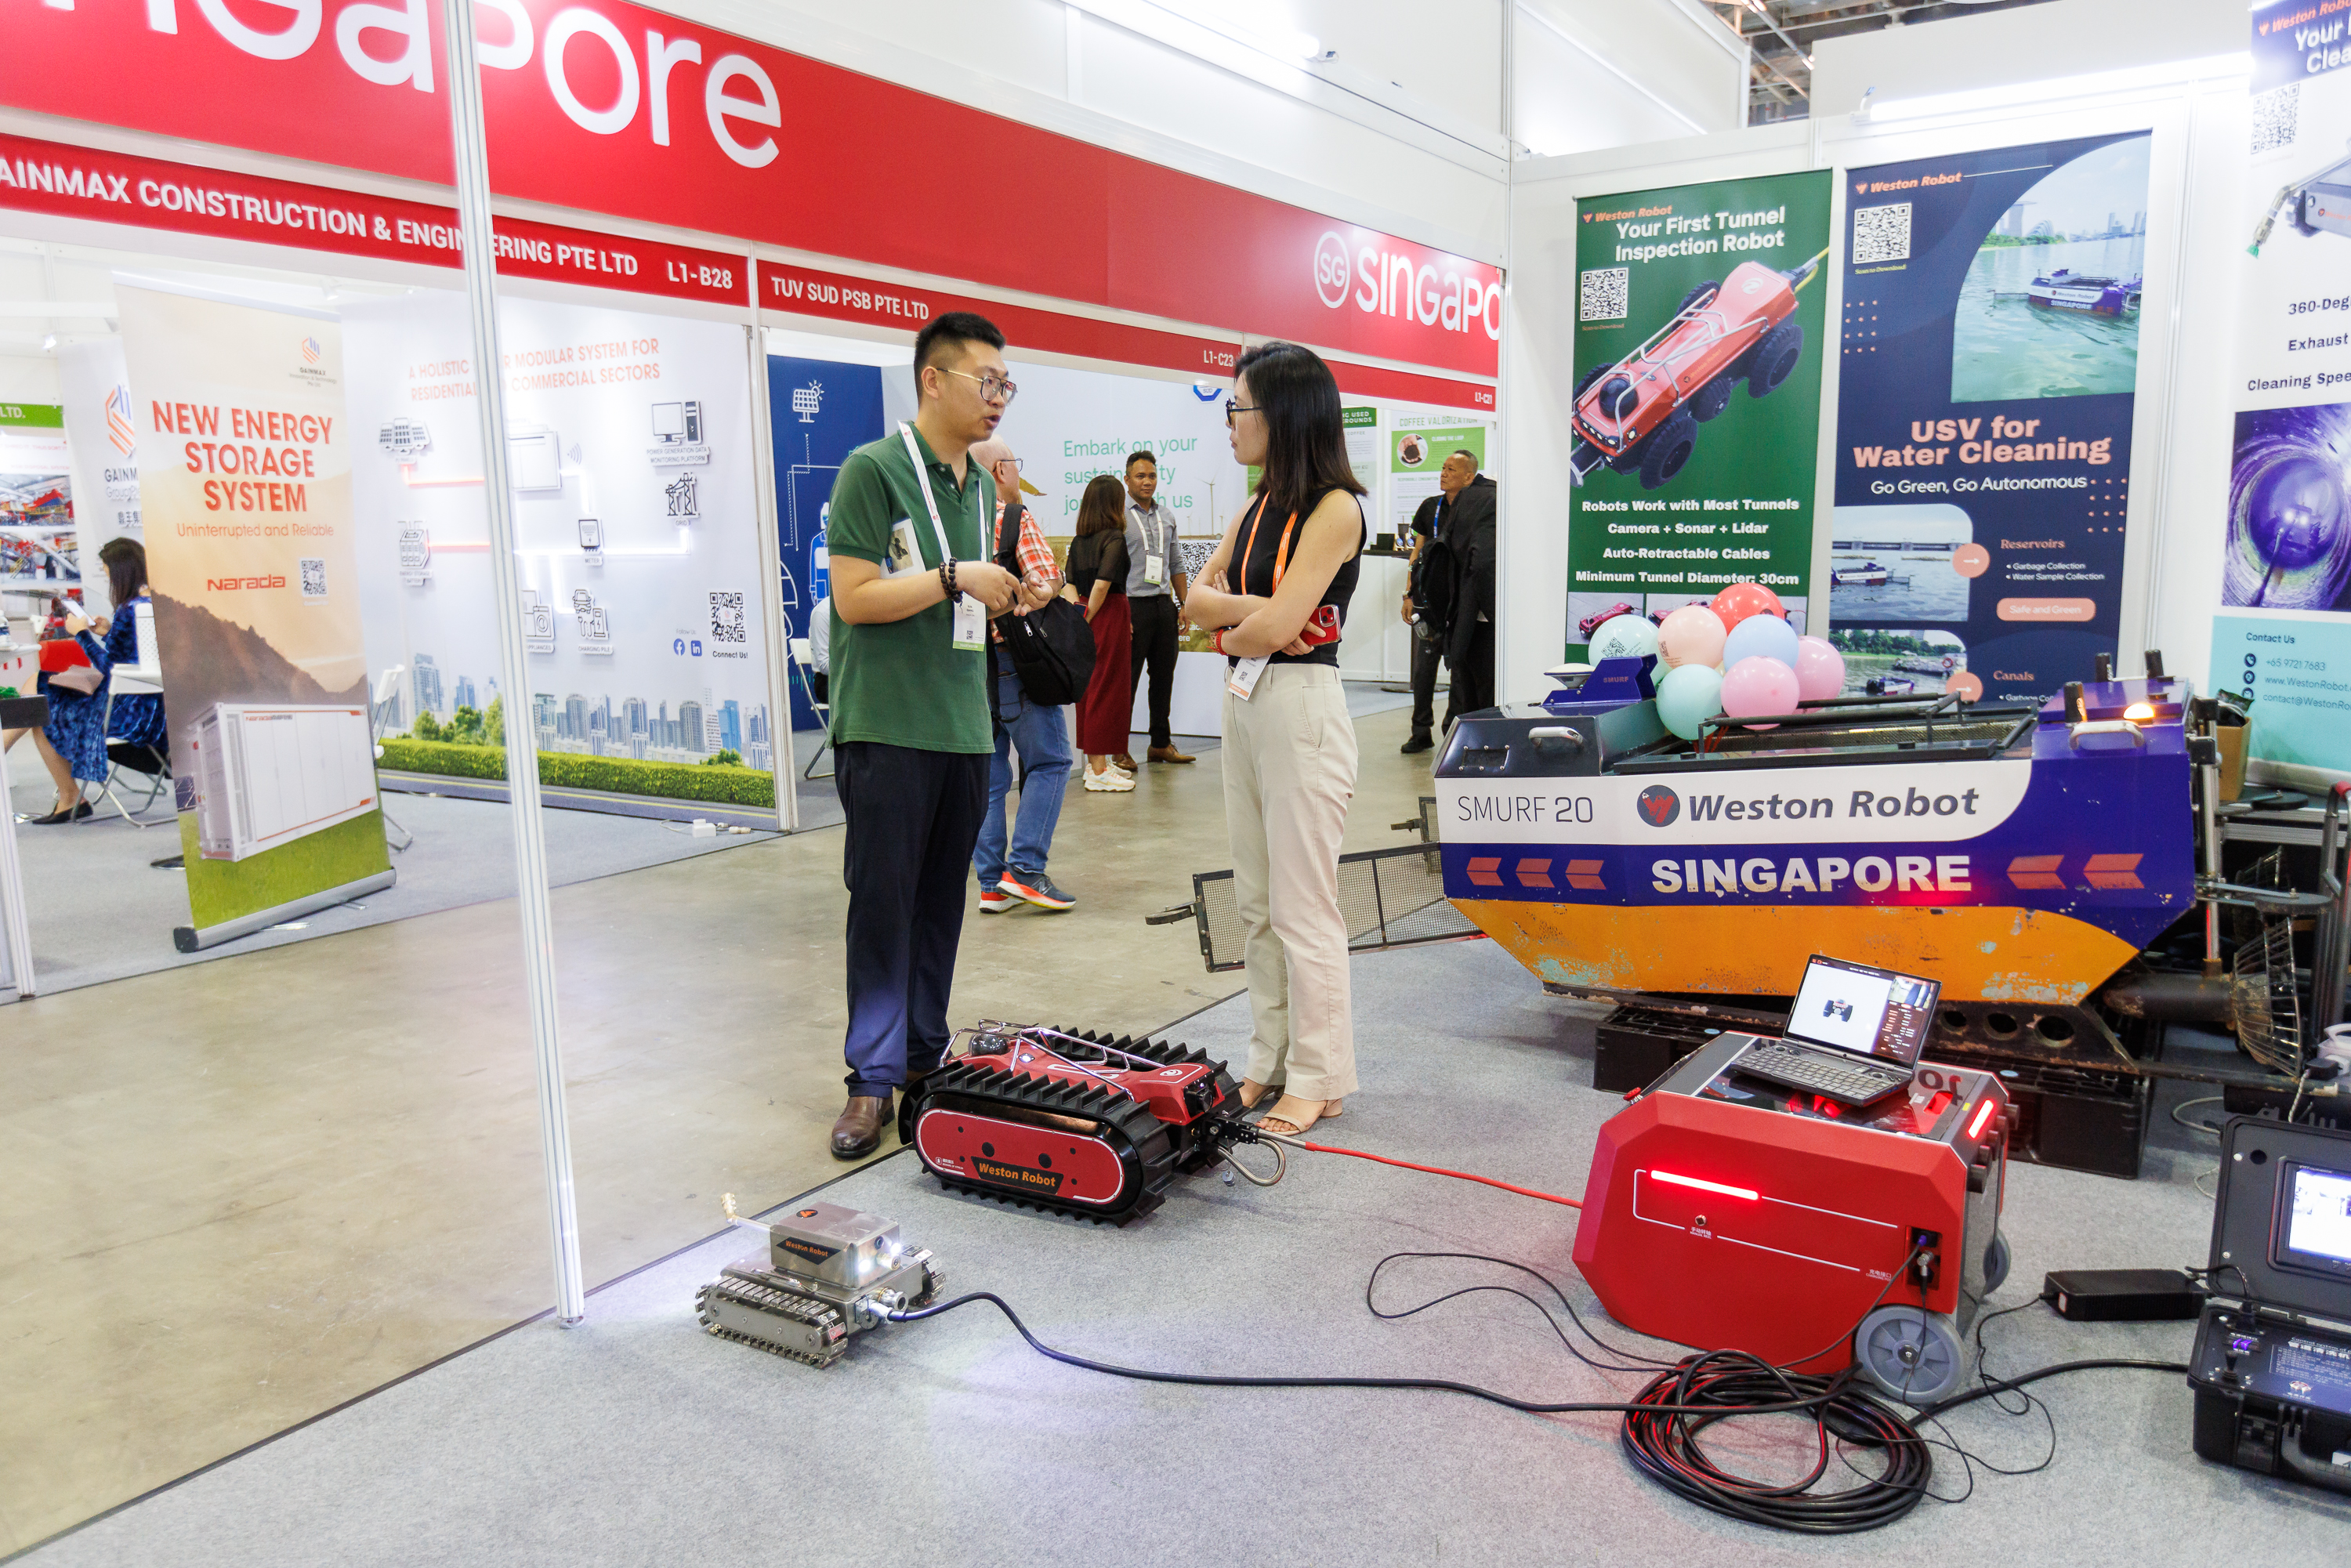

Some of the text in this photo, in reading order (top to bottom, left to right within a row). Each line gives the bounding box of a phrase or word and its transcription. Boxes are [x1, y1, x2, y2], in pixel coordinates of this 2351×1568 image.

[2273, 8, 2317, 32] Weston
[2295, 19, 2343, 51] Your
[2306, 47, 2351, 73] Clea
[1871, 172, 1963, 193] Weston Robot
[1596, 205, 1672, 223] Weston Robot
[1616, 206, 1786, 239] Your First Tunnel
[139, 181, 368, 237] CONSTRUCTION
[374, 216, 392, 241] &
[397, 219, 552, 264] ENGINRING
[556, 247, 596, 273] PTE
[601, 251, 638, 276] LTD
[1615, 230, 1784, 263] Inspection Robot
[667, 259, 734, 291] L1-B28
[1319, 251, 1346, 289] SG
[771, 275, 929, 321] TUV SUD PSB PTE LTD
[2050, 300, 2092, 310] SINGAPORE
[2288, 295, 2351, 315] 360-Deg
[2288, 332, 2349, 352] Exhaust
[515, 347, 574, 368] MODULAR
[578, 342, 627, 361] SYSTEM
[632, 338, 659, 356] FOR
[1203, 349, 1234, 368] L1-C23
[409, 366, 416, 379] A
[419, 359, 469, 378] HOLISTIC
[512, 363, 660, 392] COMMERCIAL SECTORS
[411, 382, 477, 401] RESIDENTIAL
[2248, 375, 2311, 391] Cleaning
[0, 406, 26, 418] LTD.
[152, 400, 333, 444] NEW ENERGY
[1400, 417, 1425, 427] COFFEE
[1911, 415, 2041, 443] USV for
[1064, 437, 1197, 457] Embark on your
[1853, 436, 2112, 469] Water Cleaning
[185, 441, 315, 478] STORAGE
[1871, 476, 2088, 494] Go Green, Go Autonomous
[204, 480, 307, 512] SYSTEM
[1173, 494, 1193, 509] us
[1582, 498, 1800, 512] Robots Work with Most Tunnels
[176, 523, 334, 540] Uninterrupted and Reliable
[1607, 523, 1660, 534] Camera
[1675, 523, 1715, 534] Sonar
[1732, 523, 1769, 534] Lidar
[1603, 548, 1770, 559] Auto-Retractable Cables
[2001, 538, 2066, 549] Reservoirs
[2012, 562, 2086, 571] Garbage Collection
[208, 574, 286, 591] Narada
[1575, 570, 1799, 585] Minimum Tunnel Diameter: 30cm
[2035, 573, 2064, 581] Sample
[2009, 605, 2082, 614] Safe and Green
[2246, 632, 2295, 644] Contact Us
[2266, 658, 2281, 667] +65
[1993, 670, 2035, 681] Canals
[1458, 795, 1594, 823] SMURF 20
[1689, 787, 1980, 821] Weston Robot
[1651, 855, 1972, 893] SINGAPORE
[980, 1163, 1018, 1179] Weston
[1022, 1171, 1056, 1187] Robot
[785, 1240, 828, 1257] Weston Robot
